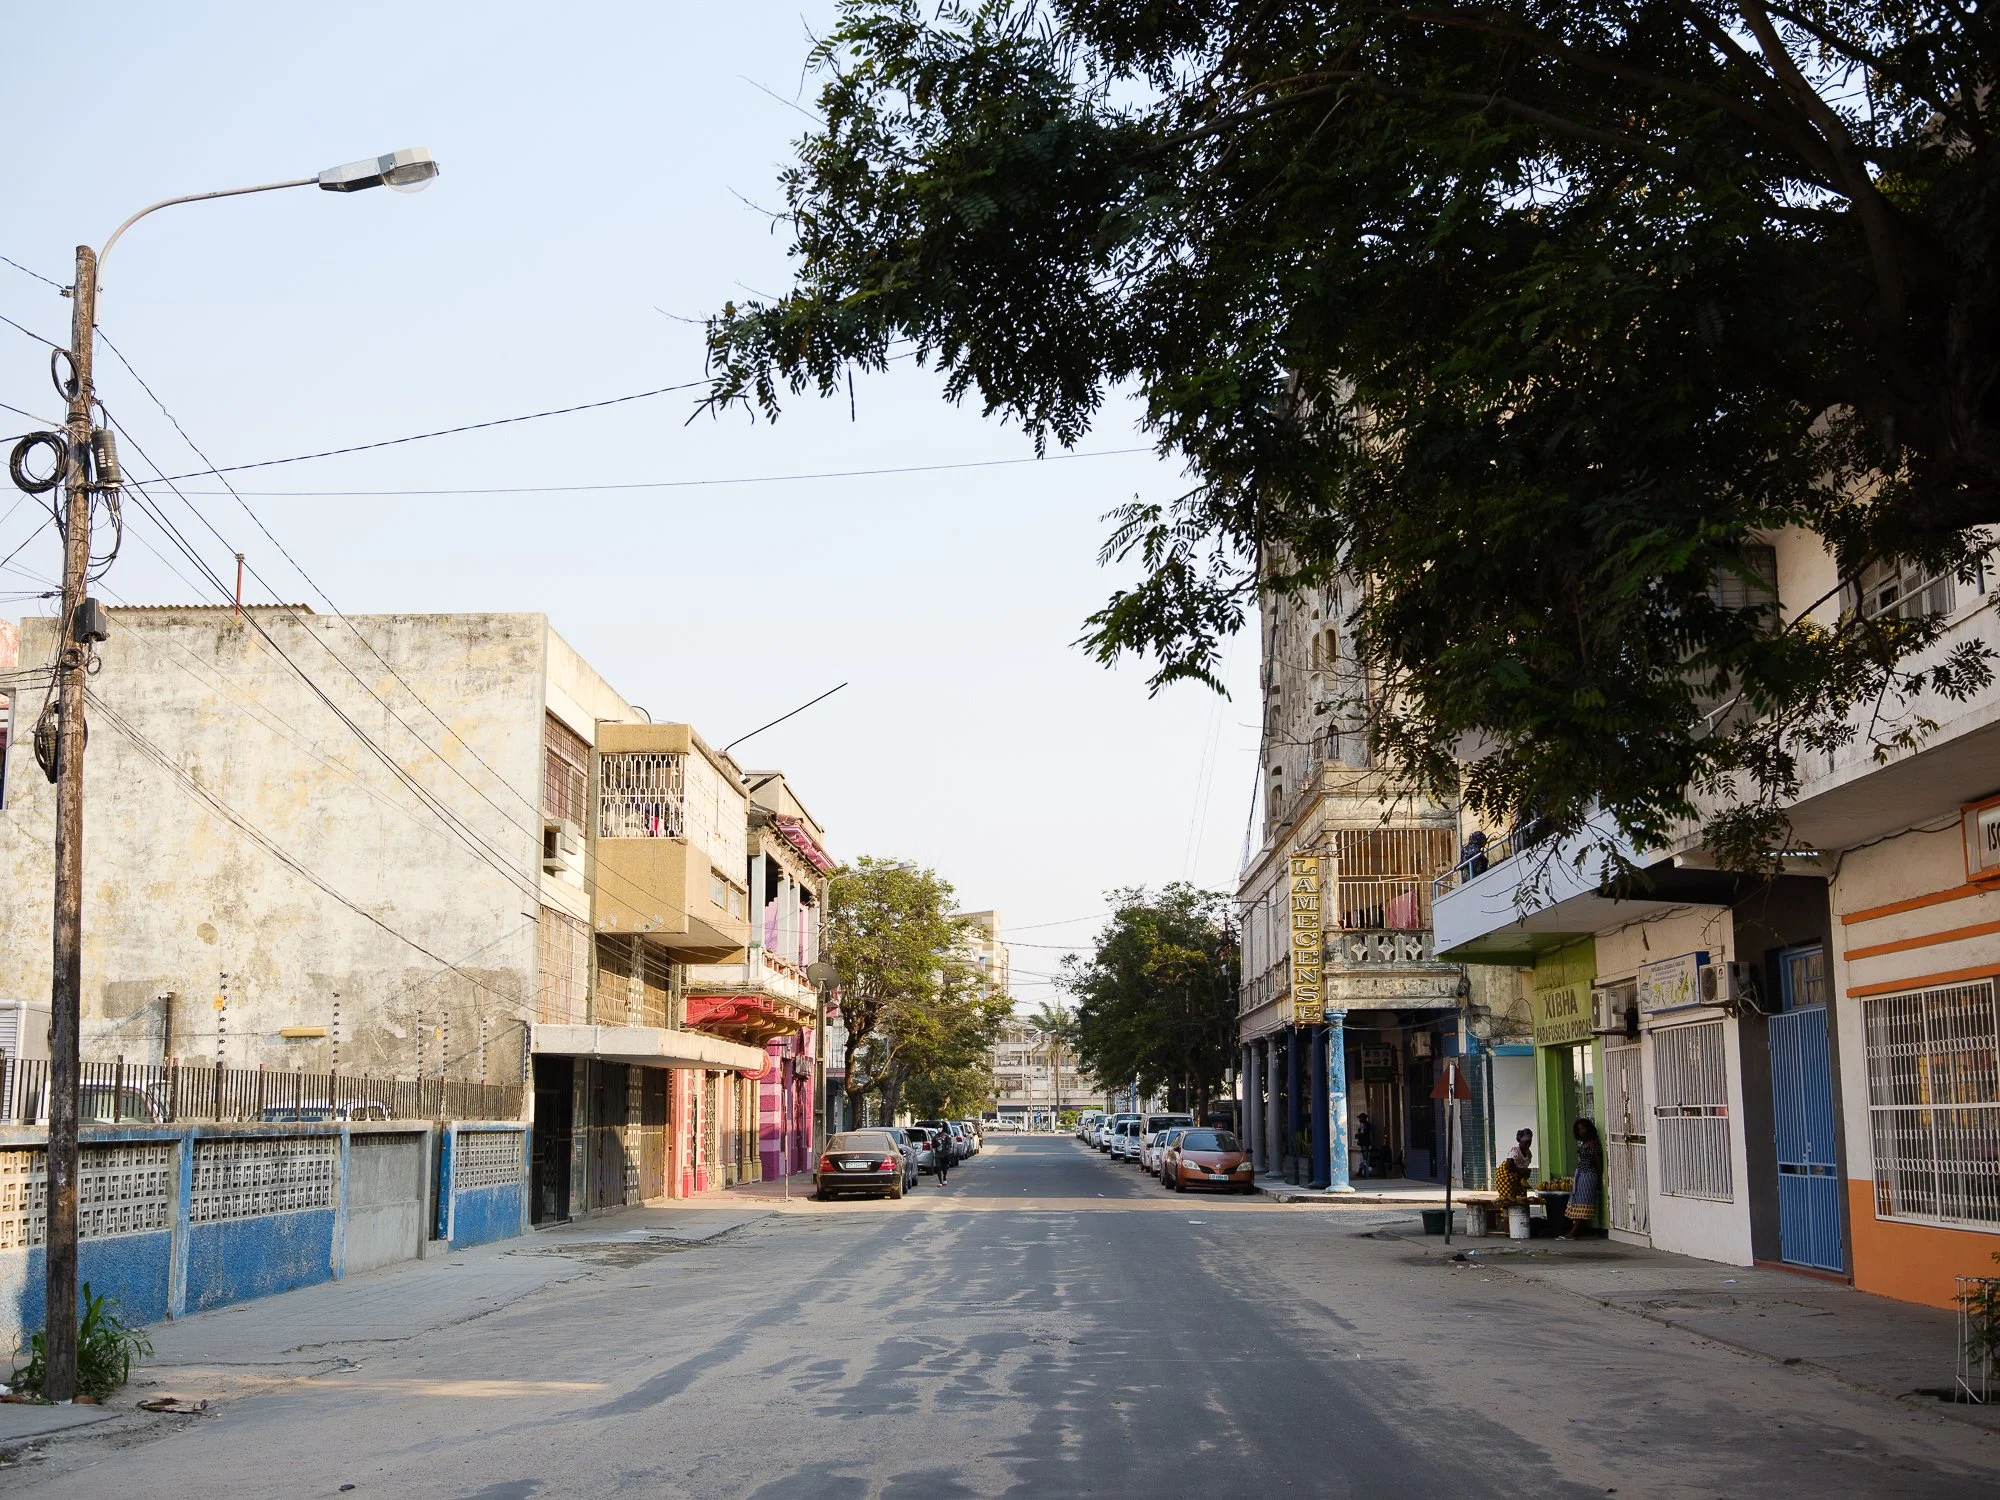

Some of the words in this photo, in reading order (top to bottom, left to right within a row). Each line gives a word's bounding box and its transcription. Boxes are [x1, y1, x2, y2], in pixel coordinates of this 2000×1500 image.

[1292, 859, 1321, 1022] LAMECENSE
[1544, 988, 1578, 1020] XIBHA
[1536, 1023, 1565, 1044] PARAFUSOS
[1566, 1022, 1571, 1040] &
[1571, 1018, 1593, 1039] PORCAS
